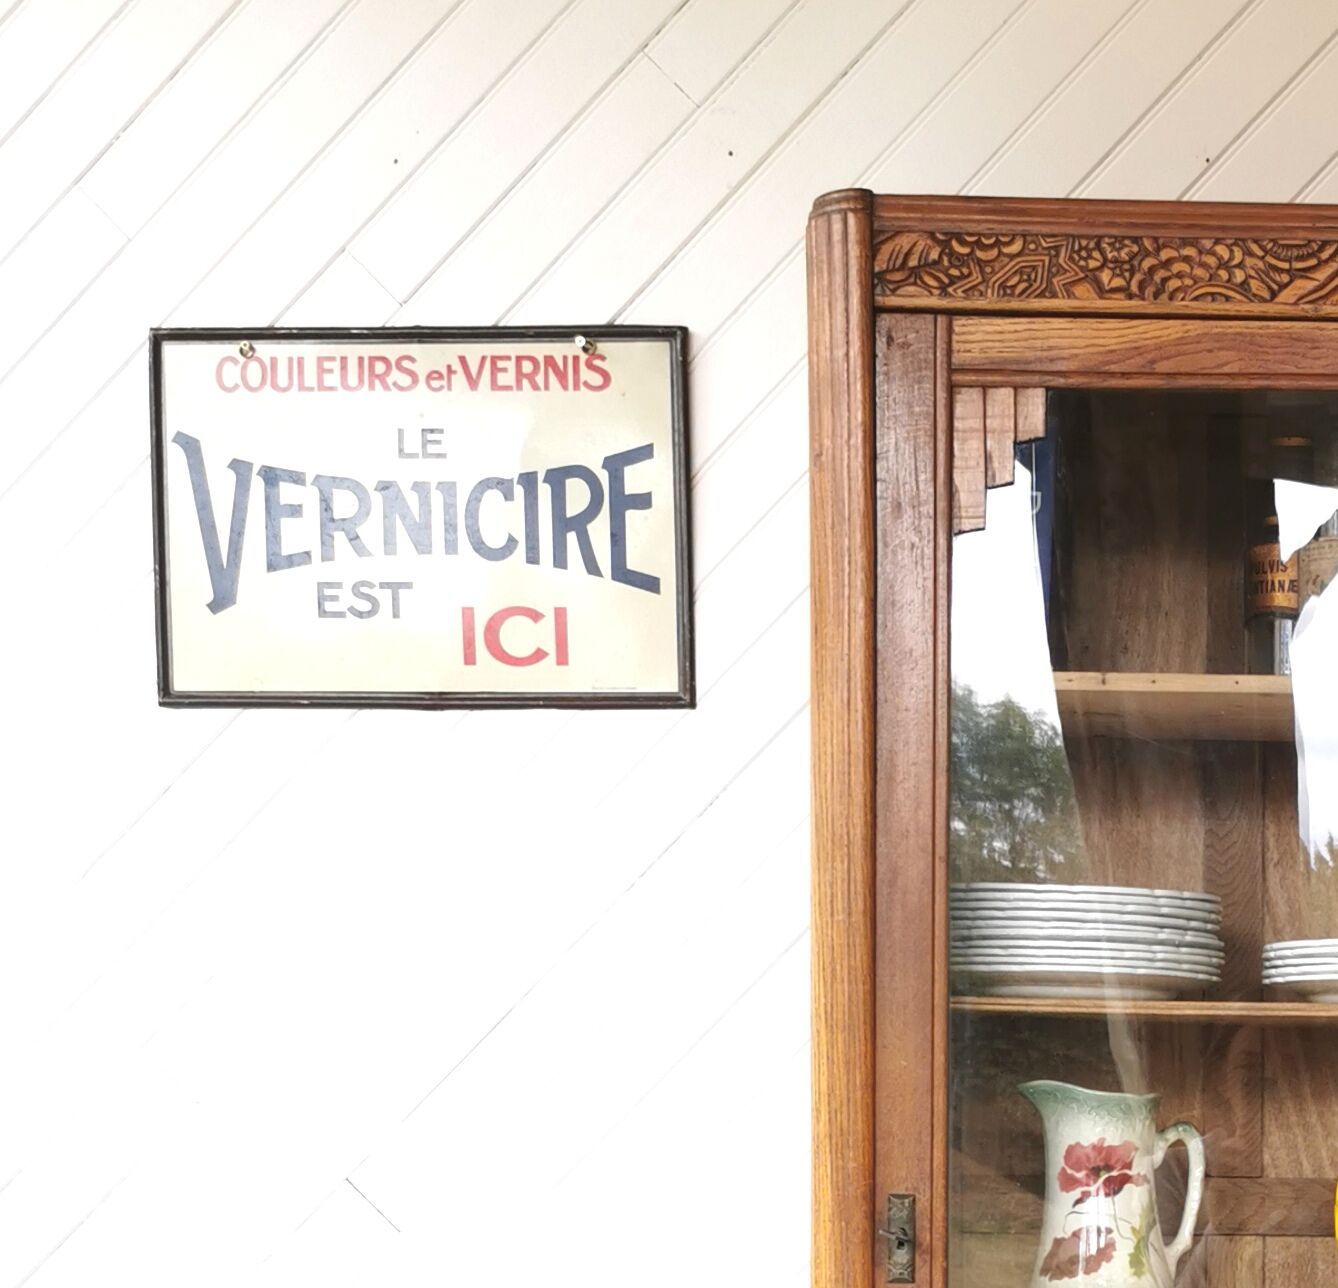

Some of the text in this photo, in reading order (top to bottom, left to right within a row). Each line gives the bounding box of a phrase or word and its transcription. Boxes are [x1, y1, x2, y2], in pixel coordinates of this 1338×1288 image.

[215, 354, 612, 393] COULEURS et VERNIS
[397, 428, 447, 459] LE
[170, 430, 662, 616] VERNICIRE
[317, 581, 413, 619] EST
[461, 606, 569, 667] ICI
